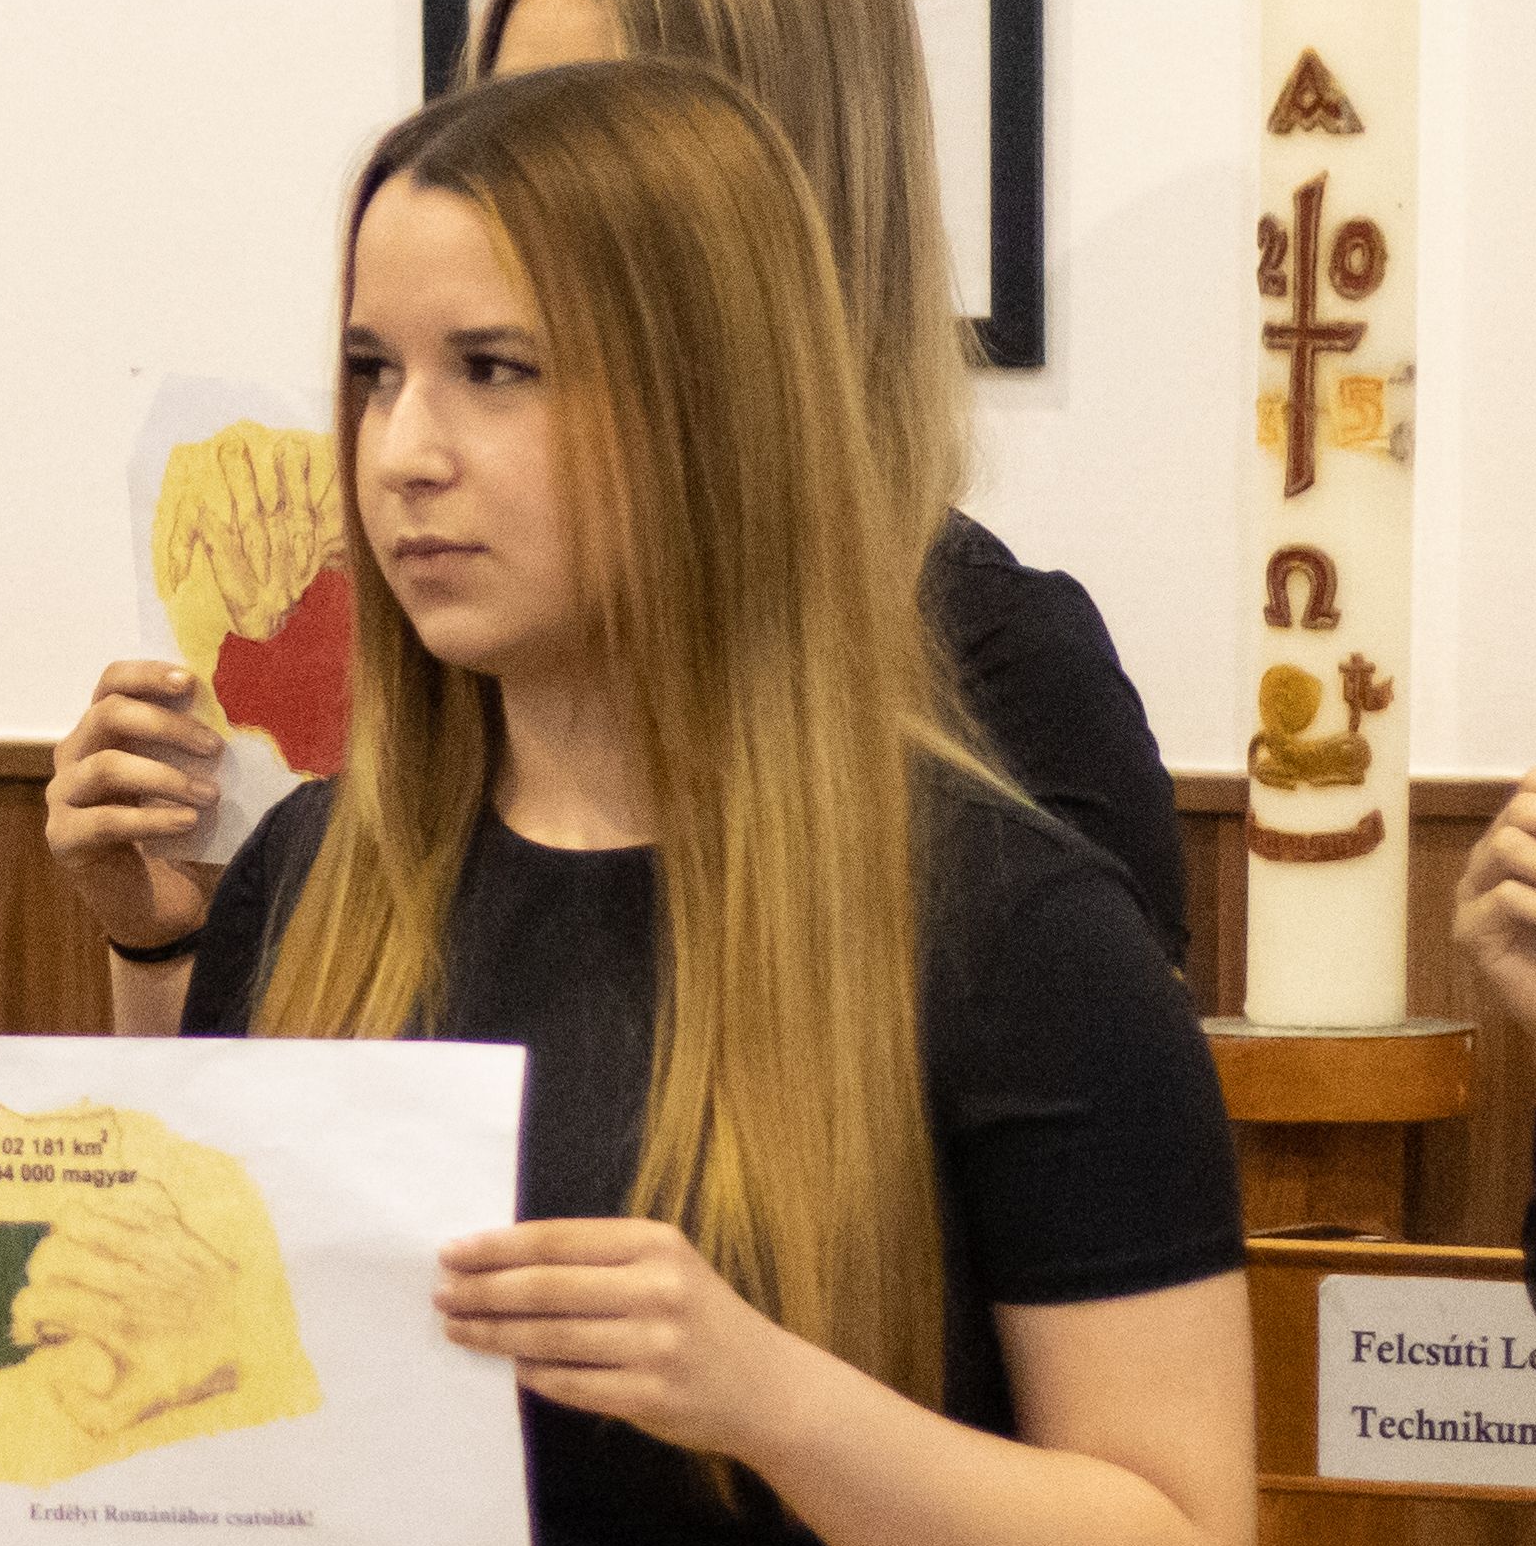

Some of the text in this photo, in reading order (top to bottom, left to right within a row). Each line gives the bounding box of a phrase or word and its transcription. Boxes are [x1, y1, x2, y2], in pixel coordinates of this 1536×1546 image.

[32, 1137, 64, 1157] 181
[21, 1163, 55, 1182] 000
[62, 1168, 138, 1189] magyar
[1351, 1329, 1489, 1369] Felcsúti
